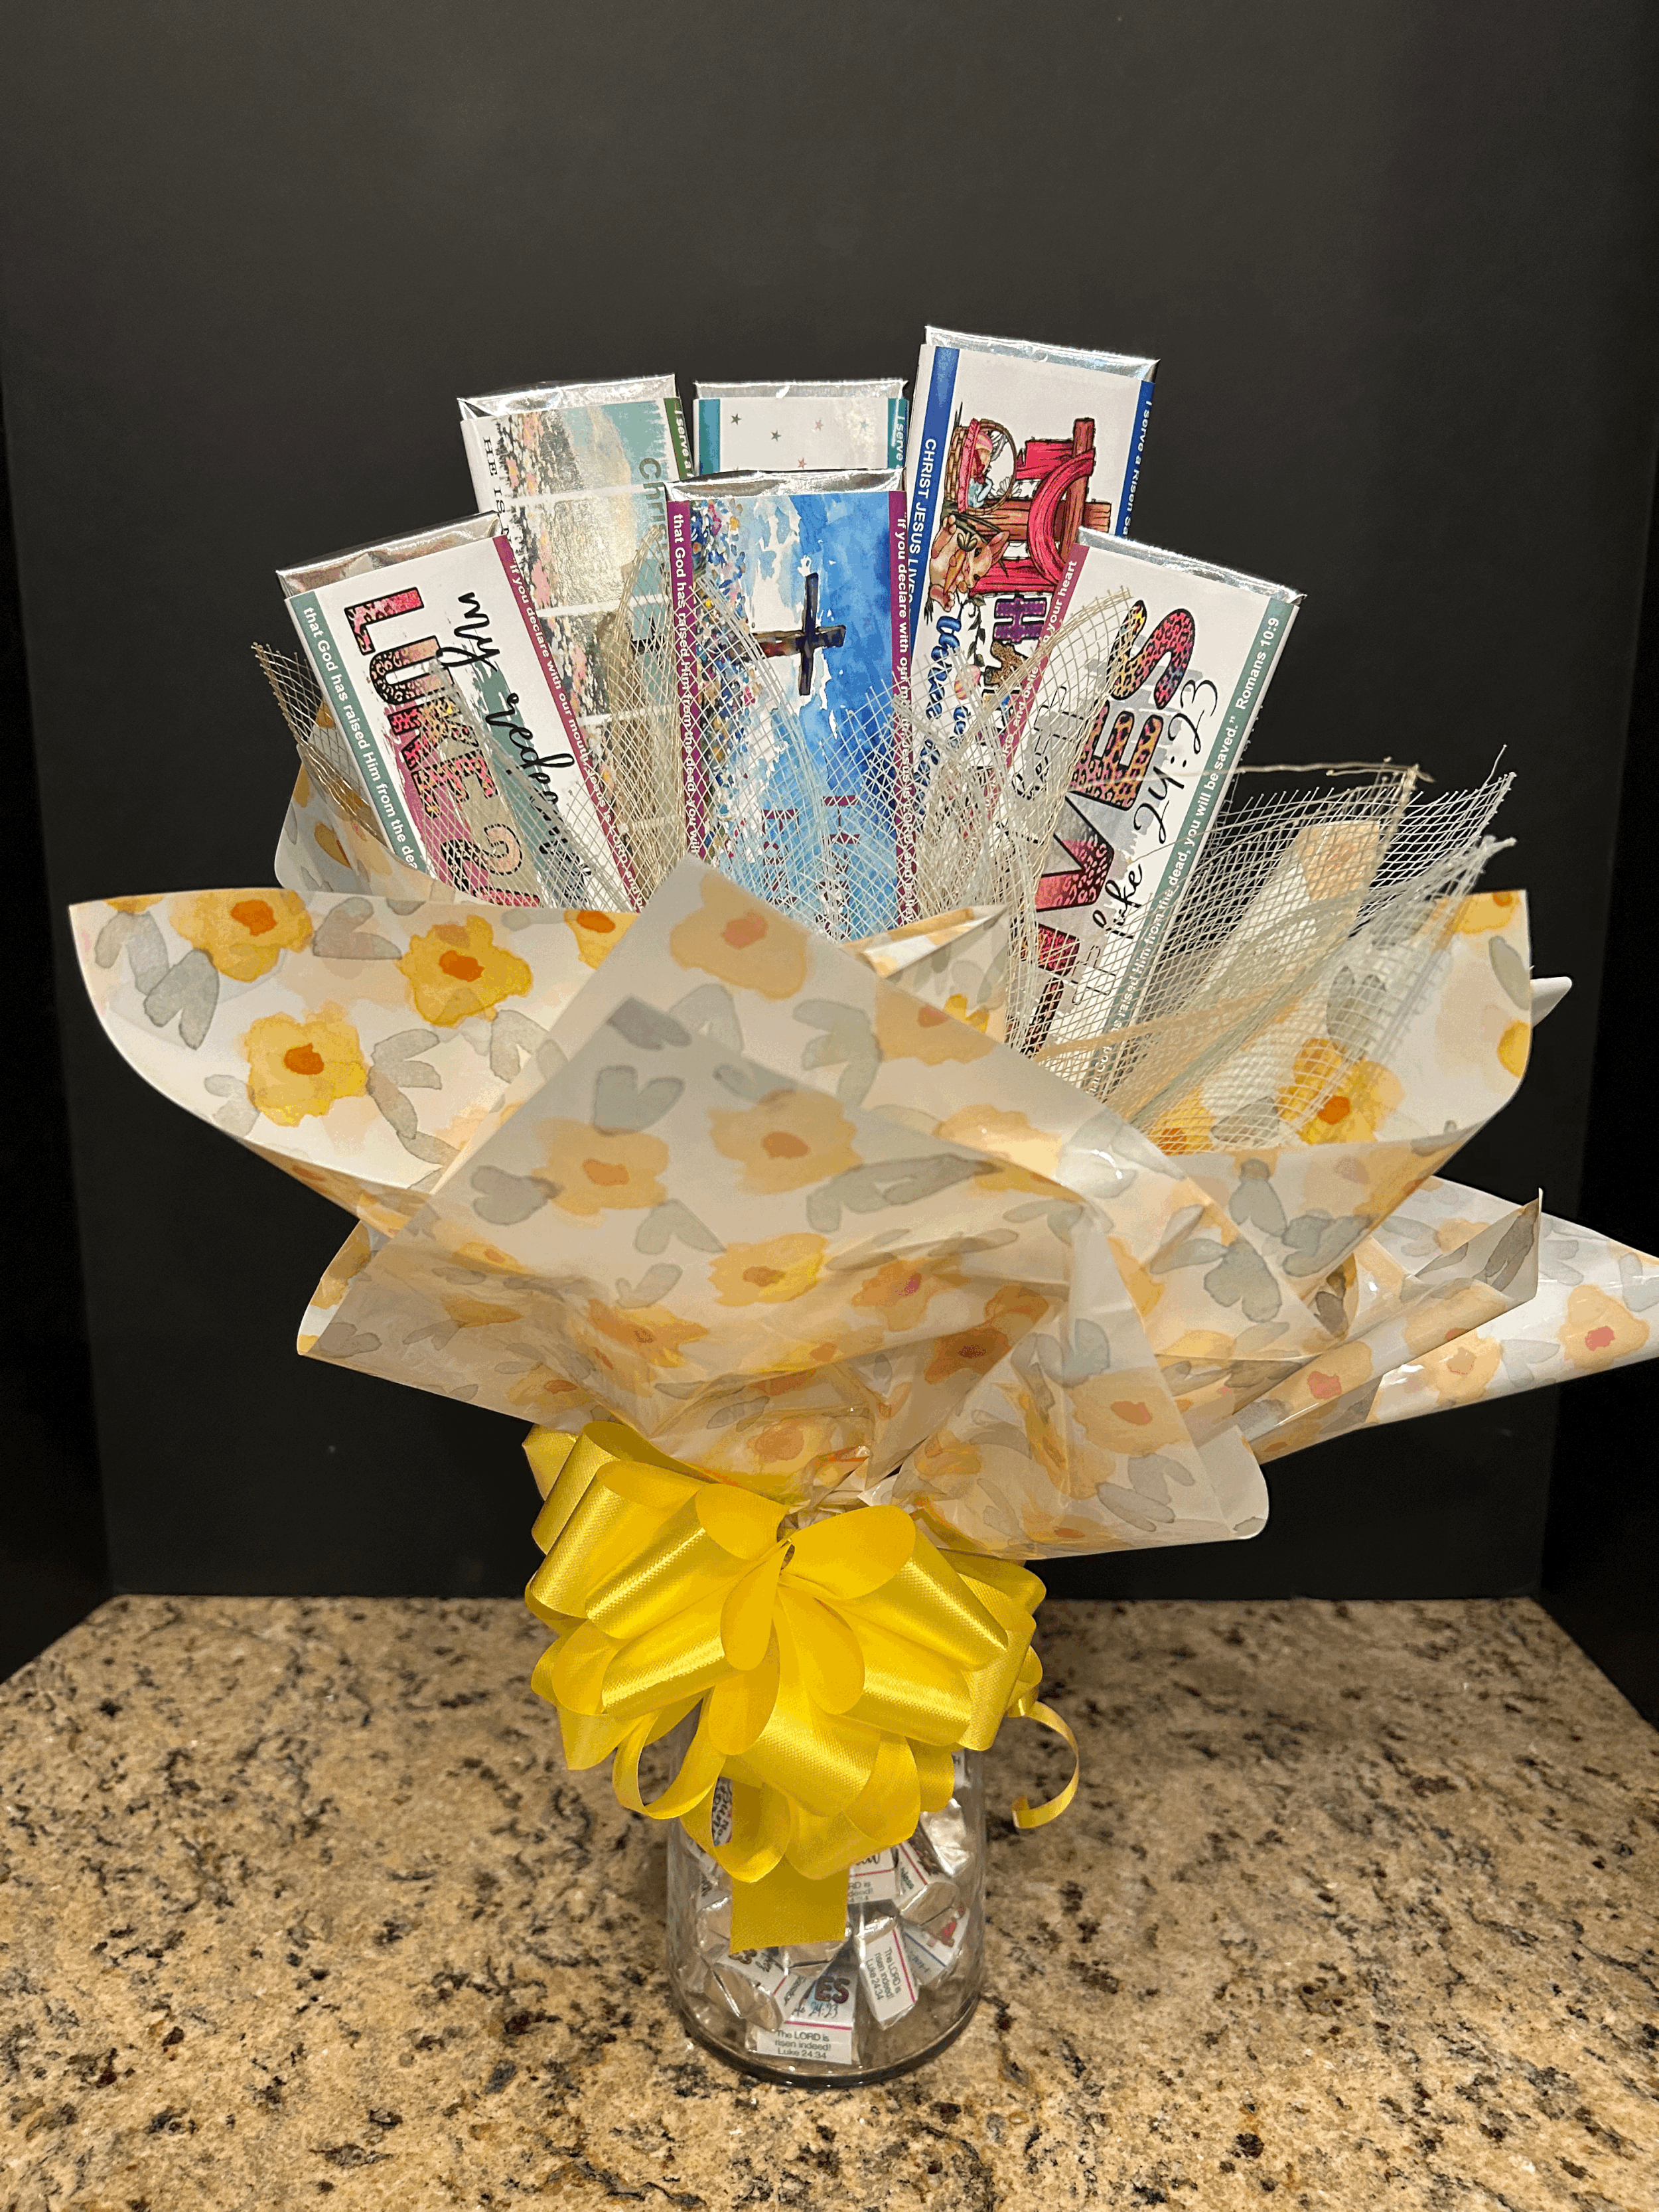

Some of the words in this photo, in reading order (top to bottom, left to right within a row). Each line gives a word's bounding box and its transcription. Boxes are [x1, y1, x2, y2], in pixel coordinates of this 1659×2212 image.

[676, 417, 689, 457] serve
[1137, 409, 1150, 453] serve
[483, 436, 498, 477] HE
[493, 486, 506, 515] IS
[918, 438, 936, 499] CHRIST
[1135, 455, 1141, 465] a
[1126, 469, 1140, 512] Risen
[673, 514, 684, 544] that
[895, 532, 906, 559] you
[908, 502, 927, 554] JESUS
[674, 546, 686, 578] God
[677, 582, 687, 609] has
[898, 563, 908, 619] declare
[1047, 600, 1063, 632] your
[1057, 560, 1078, 594] heart
[437, 591, 500, 672] my
[512, 577, 530, 604] you
[526, 607, 549, 658] declare
[547, 660, 561, 690] with
[559, 692, 572, 717] our
[678, 613, 690, 657] raised
[899, 622, 908, 652] with
[681, 661, 690, 690] Him
[900, 656, 909, 682] our
[303, 607, 324, 638] that
[317, 640, 338, 672] God
[330, 674, 348, 701] has
[343, 704, 370, 749] raised
[363, 751, 382, 781] Him
[376, 782, 396, 818] from
[390, 819, 406, 842] the
[683, 694, 693, 727] from
[1168, 849, 1192, 887] dead,
[1185, 820, 1201, 848] you
[1195, 792, 1212, 817] will
[1204, 773, 1219, 790] be
[1234, 651, 1267, 710] Romans
[1260, 617, 1279, 647] 10:9
[774, 2039, 797, 2048] risen
[776, 2030, 793, 2039] The
[794, 2031, 822, 2041] LORD
[777, 2047, 800, 2057] Luke
